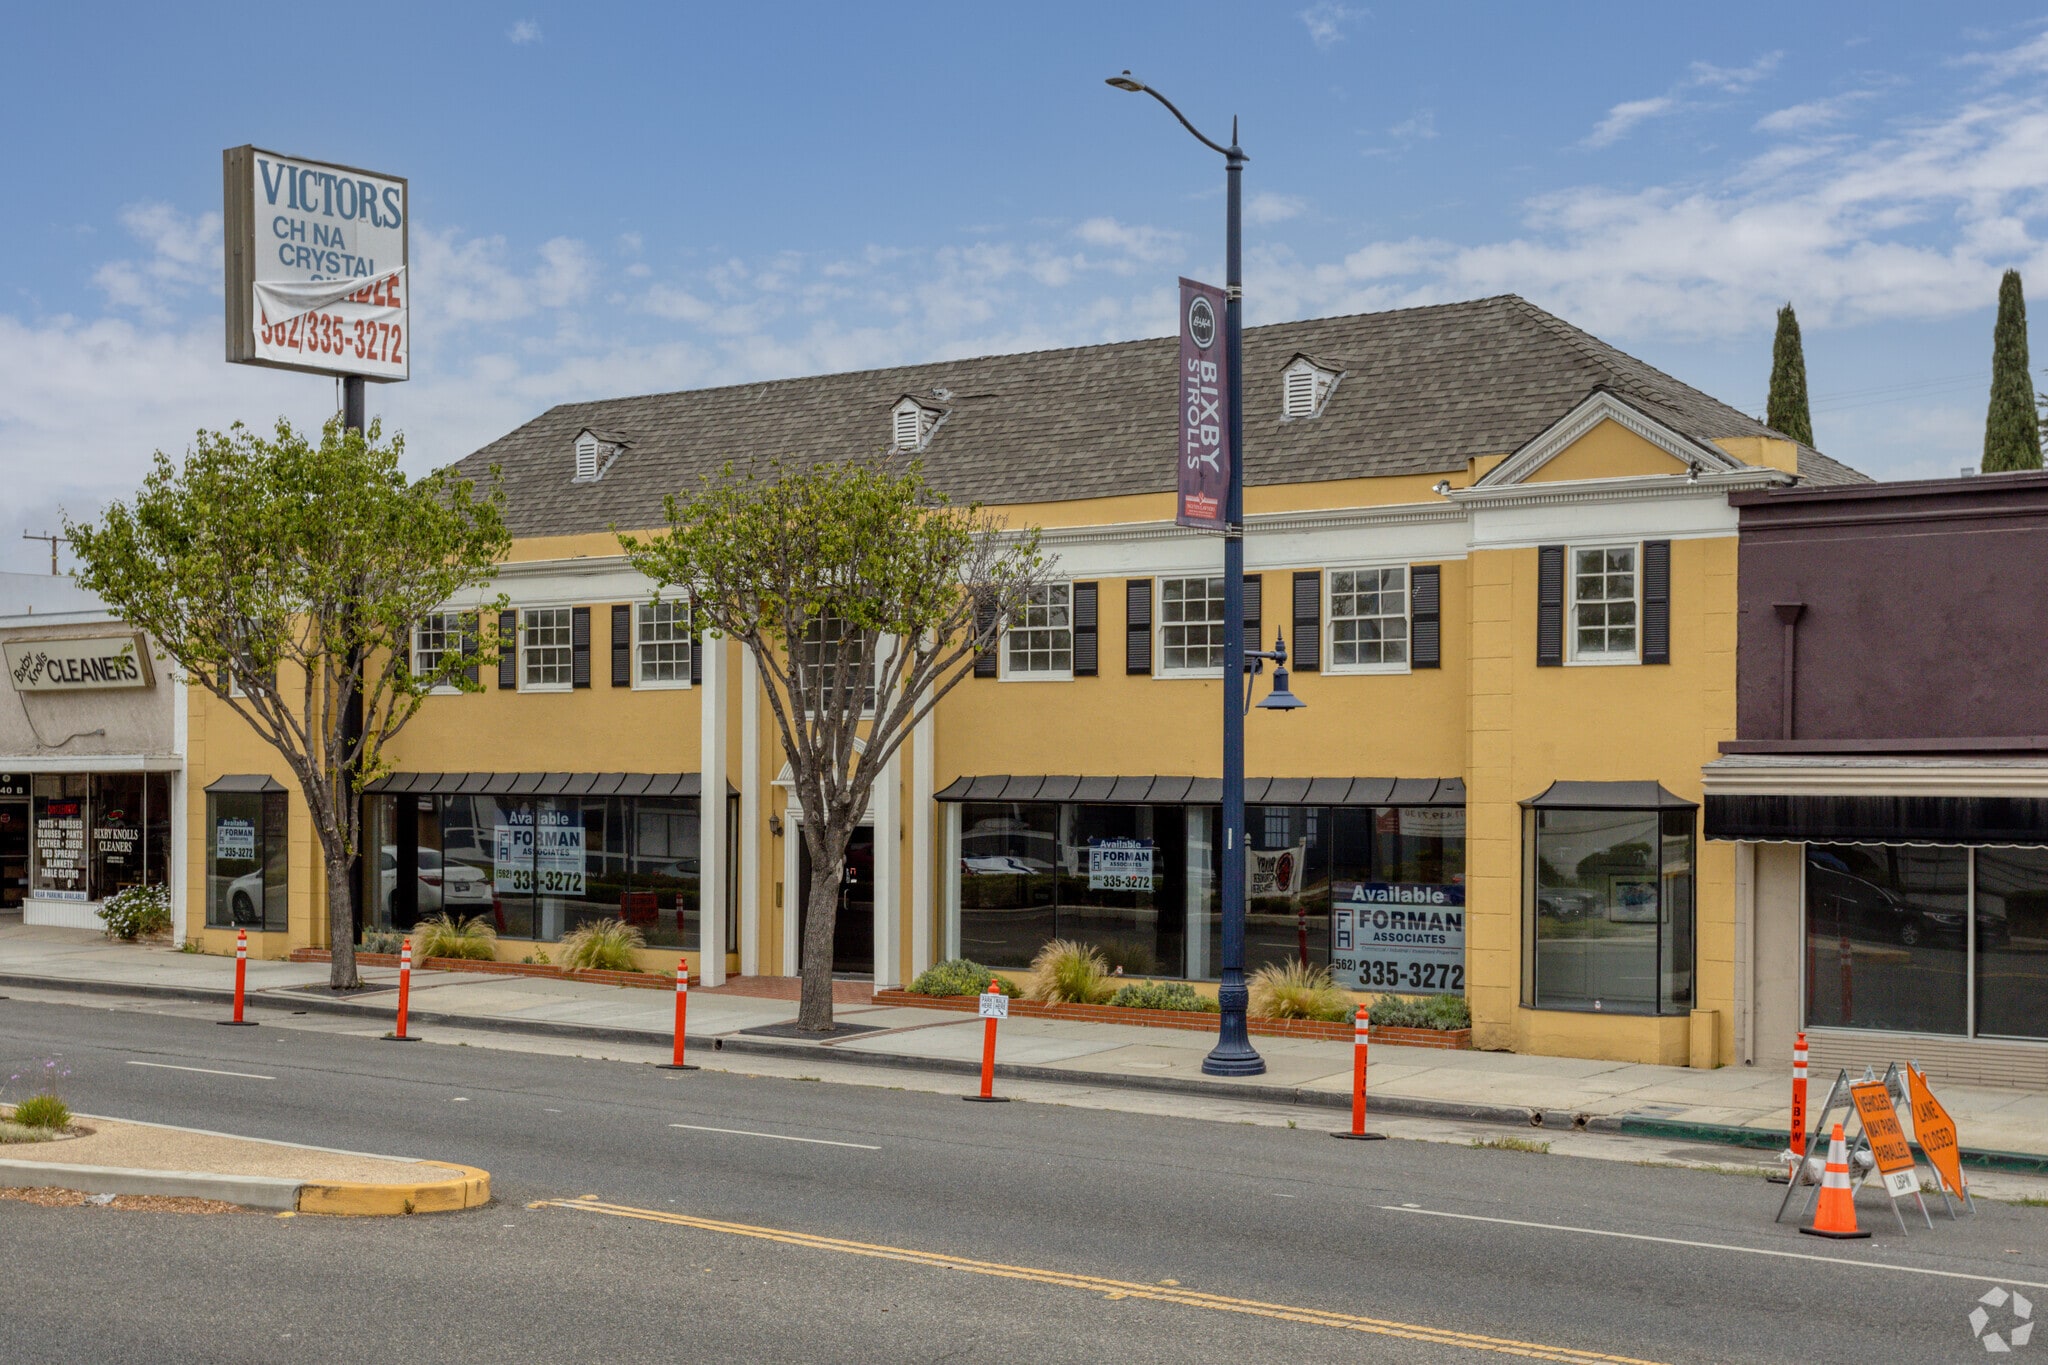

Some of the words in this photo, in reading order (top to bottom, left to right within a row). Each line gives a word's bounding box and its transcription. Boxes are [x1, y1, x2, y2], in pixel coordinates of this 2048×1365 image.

[257, 159, 402, 229] VICTORS
[1187, 357, 1201, 470] STROLLS
[1200, 360, 1220, 473] BIXBY
[13, 651, 34, 684] Bixby
[27, 651, 48, 686] Knolls
[38, 819, 54, 829] SUITS
[58, 820, 83, 830] DRESSES
[509, 811, 569, 825] Avaable
[37, 829, 61, 838] BLOUSES
[66, 829, 83, 839] PANTS
[112, 829, 139, 840] KNOLLS
[225, 829, 253, 837] FORMAN
[514, 830, 580, 846] FORMAN
[37, 838, 61, 848] LEATHER
[65, 839, 83, 849] SUEDE
[99, 841, 132, 852] CLEANERS
[1100, 840, 1142, 848] Available
[54, 849, 79, 859] SPREADS
[224, 847, 253, 858] 335-3272
[523, 847, 570, 856] ASOCIATES
[1103, 851, 1149, 861] FORMAN
[46, 859, 74, 869] BLANKETS
[41, 868, 57, 878] TABLE
[58, 869, 79, 879] CLOTHS
[1103, 875, 1150, 888] 335-3272
[64, 892, 85, 900] AVAILABLE
[1352, 885, 1445, 903] Available
[1359, 909, 1462, 932] FORMAN
[1373, 932, 1446, 944] ASSOCIATES
[1359, 959, 1464, 990] 335-3272
[1860, 1093, 1890, 1113] VEHICLES
[1915, 1100, 1939, 1123] LANE
[1866, 1119, 1883, 1138] MAY
[1880, 1117, 1899, 1136] PARK
[1923, 1127, 1953, 1152] CLOSED
[1875, 1141, 1909, 1162] PARALLEL
